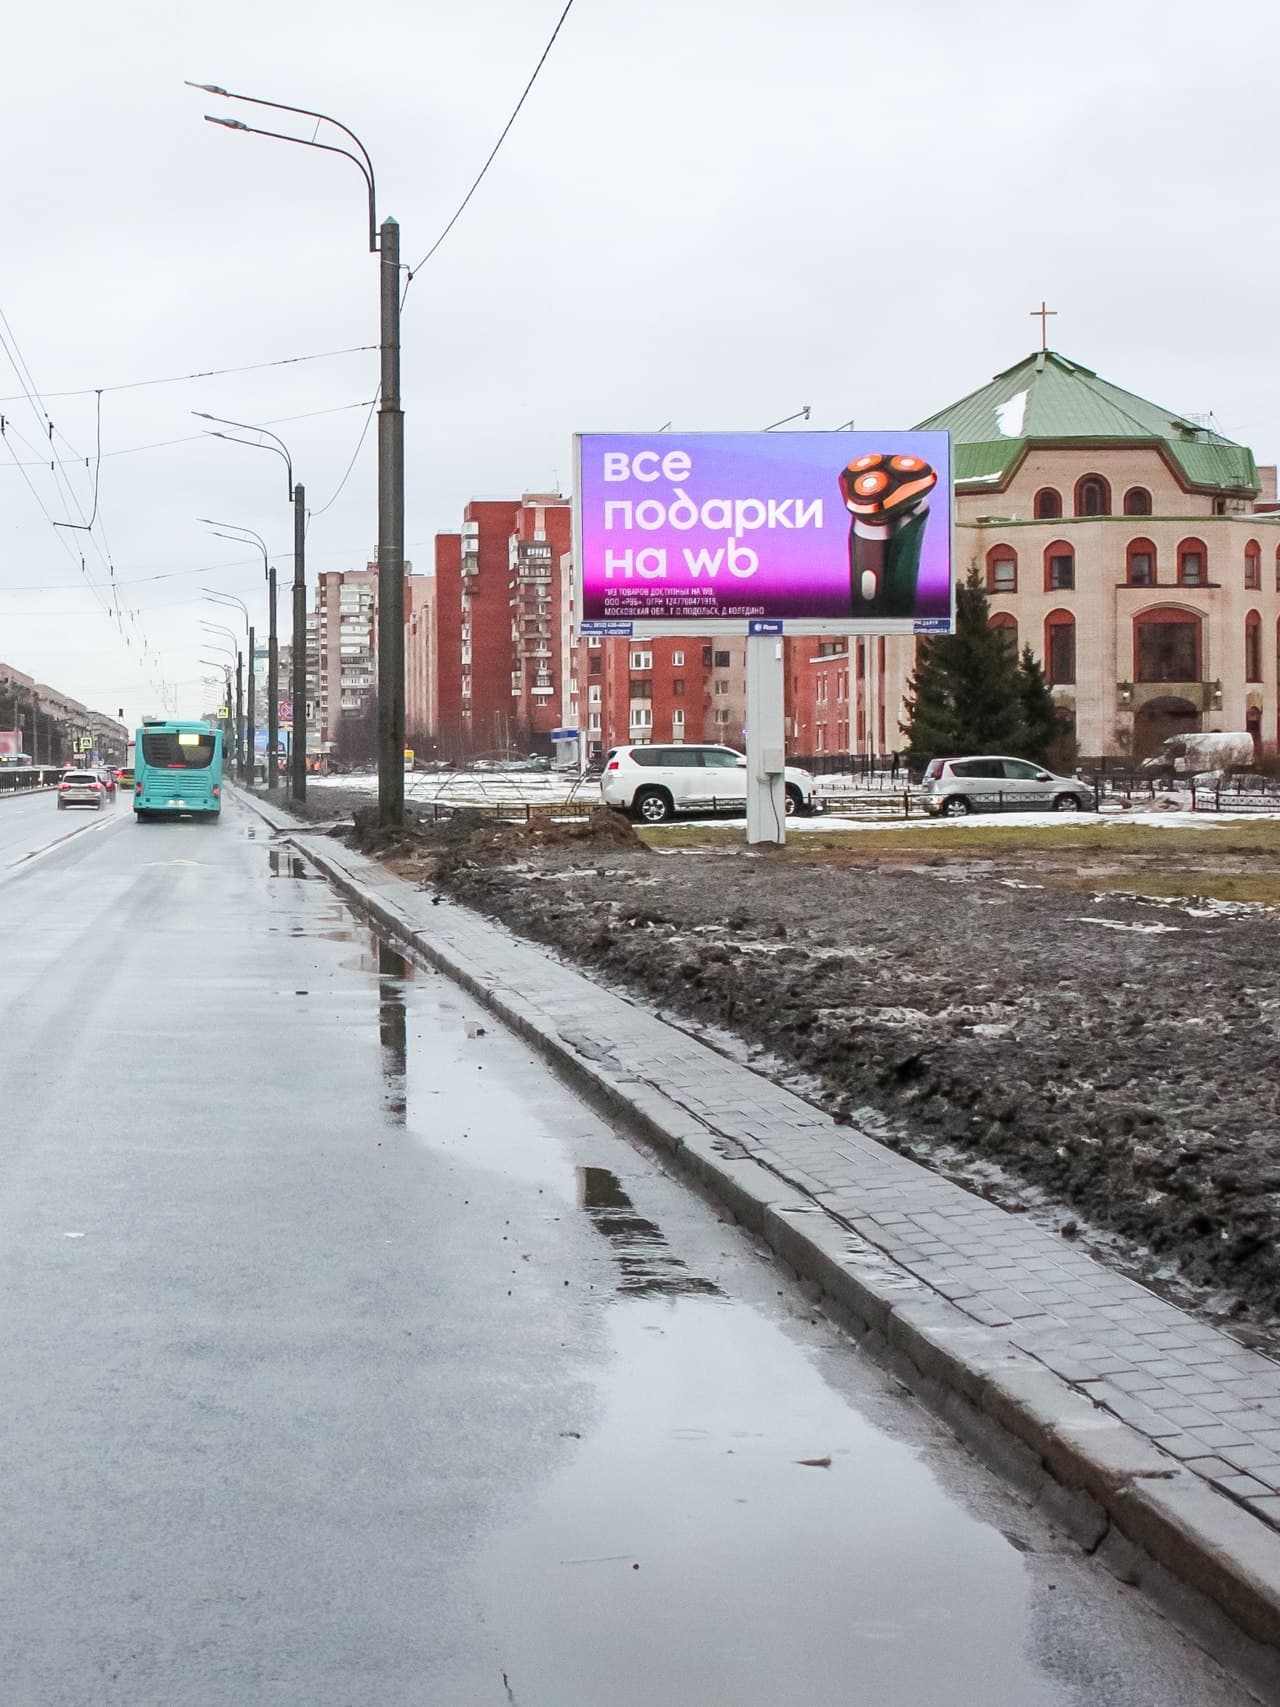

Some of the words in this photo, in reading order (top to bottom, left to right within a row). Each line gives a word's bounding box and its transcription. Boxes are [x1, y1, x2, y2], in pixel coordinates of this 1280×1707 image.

[604, 450, 692, 482] все
[604, 488, 824, 538] подарки
[605, 547, 667, 579] на
[682, 537, 759, 578] wb
[604, 598, 620, 606] ООО
[604, 607, 650, 616] МОСКОВСКАЯ
